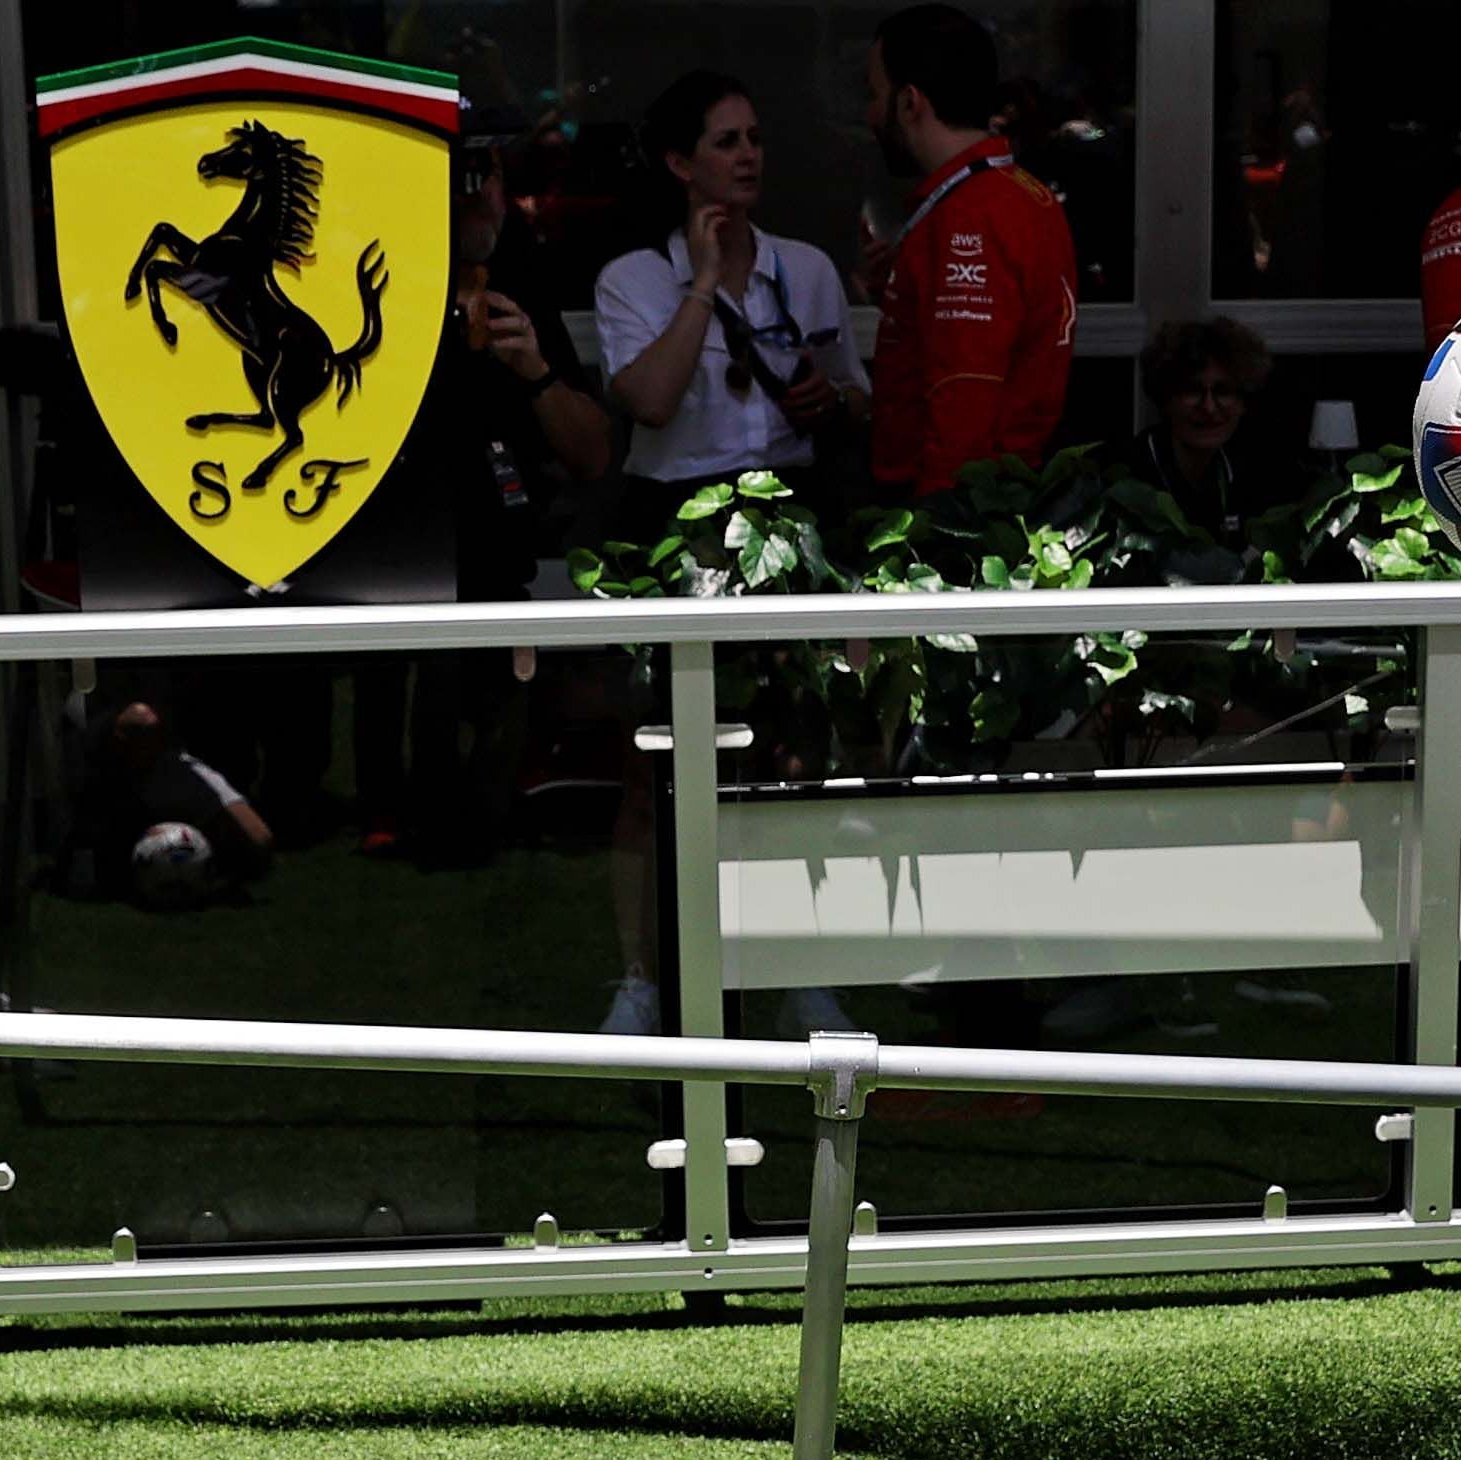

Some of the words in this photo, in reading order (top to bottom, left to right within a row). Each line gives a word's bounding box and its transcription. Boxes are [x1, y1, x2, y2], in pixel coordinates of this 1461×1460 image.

[951, 233, 983, 248] aws
[946, 263, 988, 283] DXC
[188, 460, 232, 520] S
[283, 457, 370, 518] F
